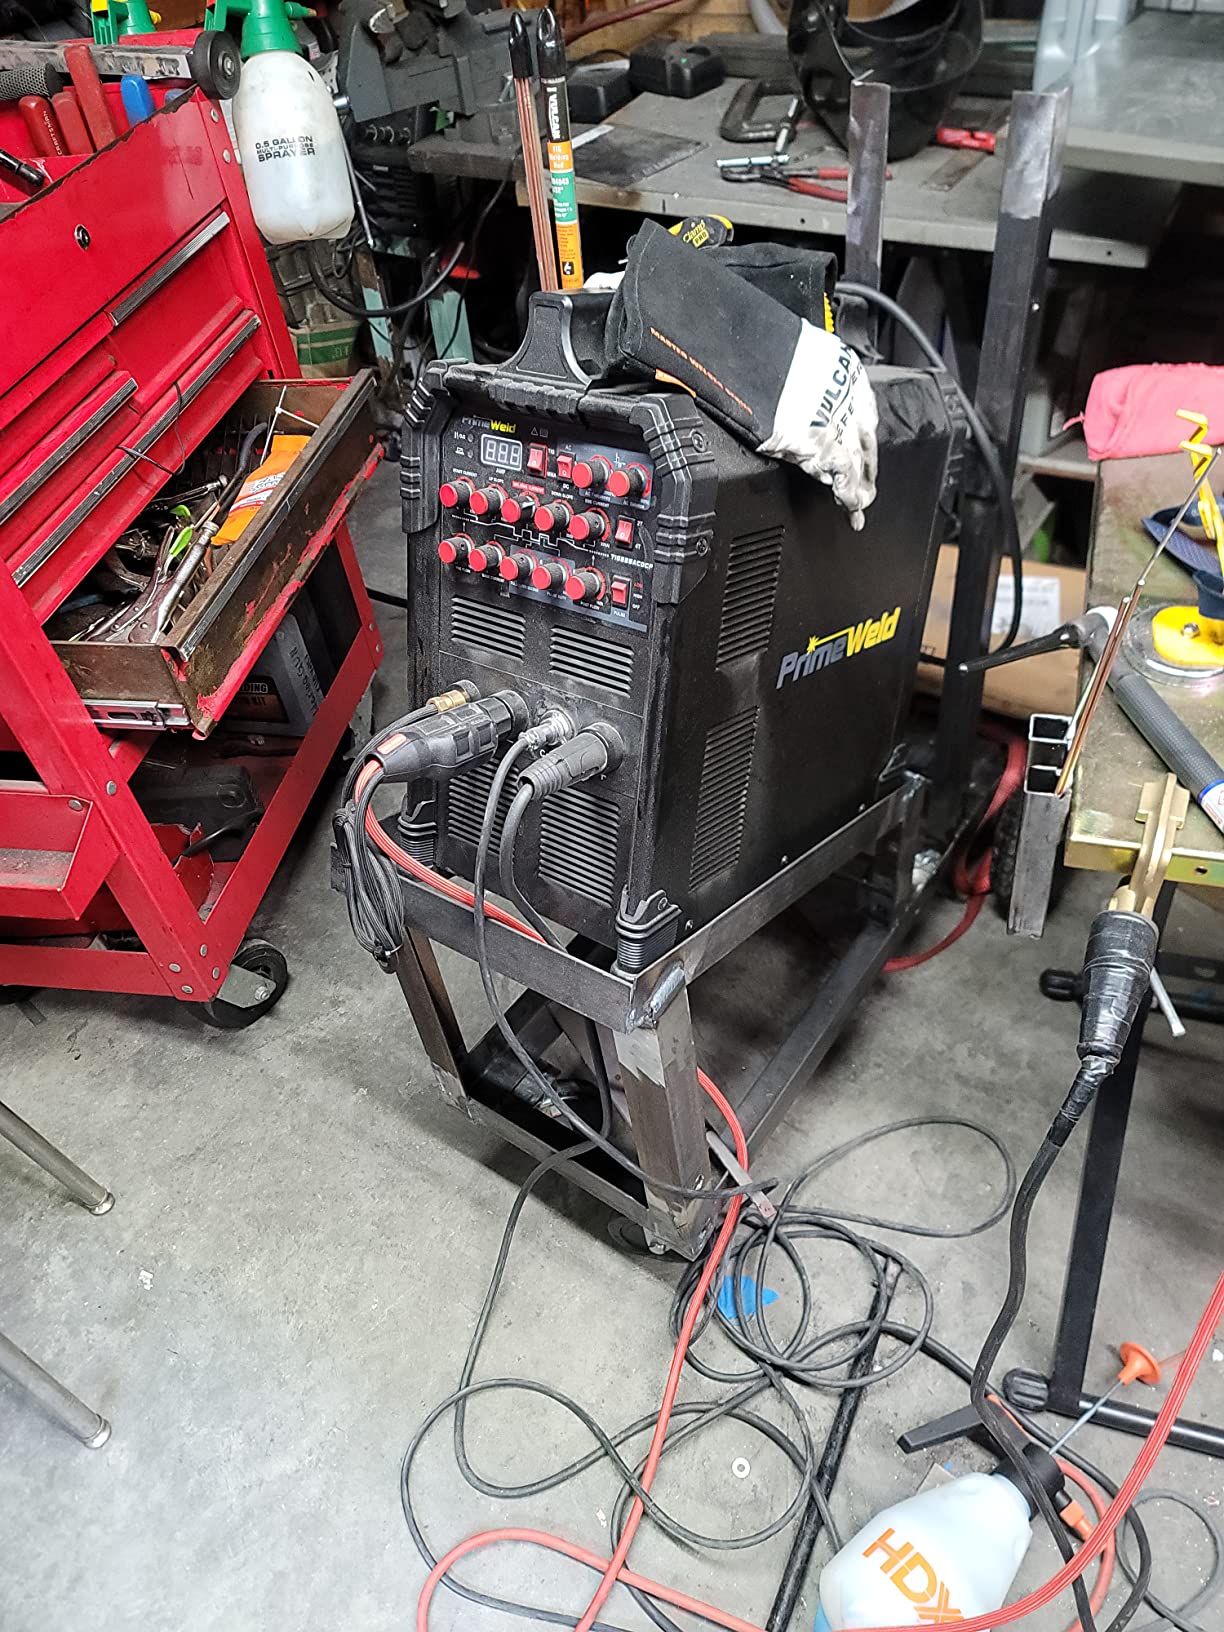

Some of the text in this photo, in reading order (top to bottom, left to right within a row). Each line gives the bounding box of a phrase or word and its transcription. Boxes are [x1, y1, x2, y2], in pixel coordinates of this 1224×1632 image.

[43, 110, 63, 156] CRAFTSMAN
[255, 135, 313, 150] 0.5 GALLON
[256, 142, 314, 155] MULTI-PUROSE
[258, 147, 316, 163] SPRAYER
[693, 230, 708, 245] PRO
[809, 344, 852, 428] VULCAN
[776, 606, 901, 690] PrimeWeld
[861, 1527, 965, 1625] HDX
